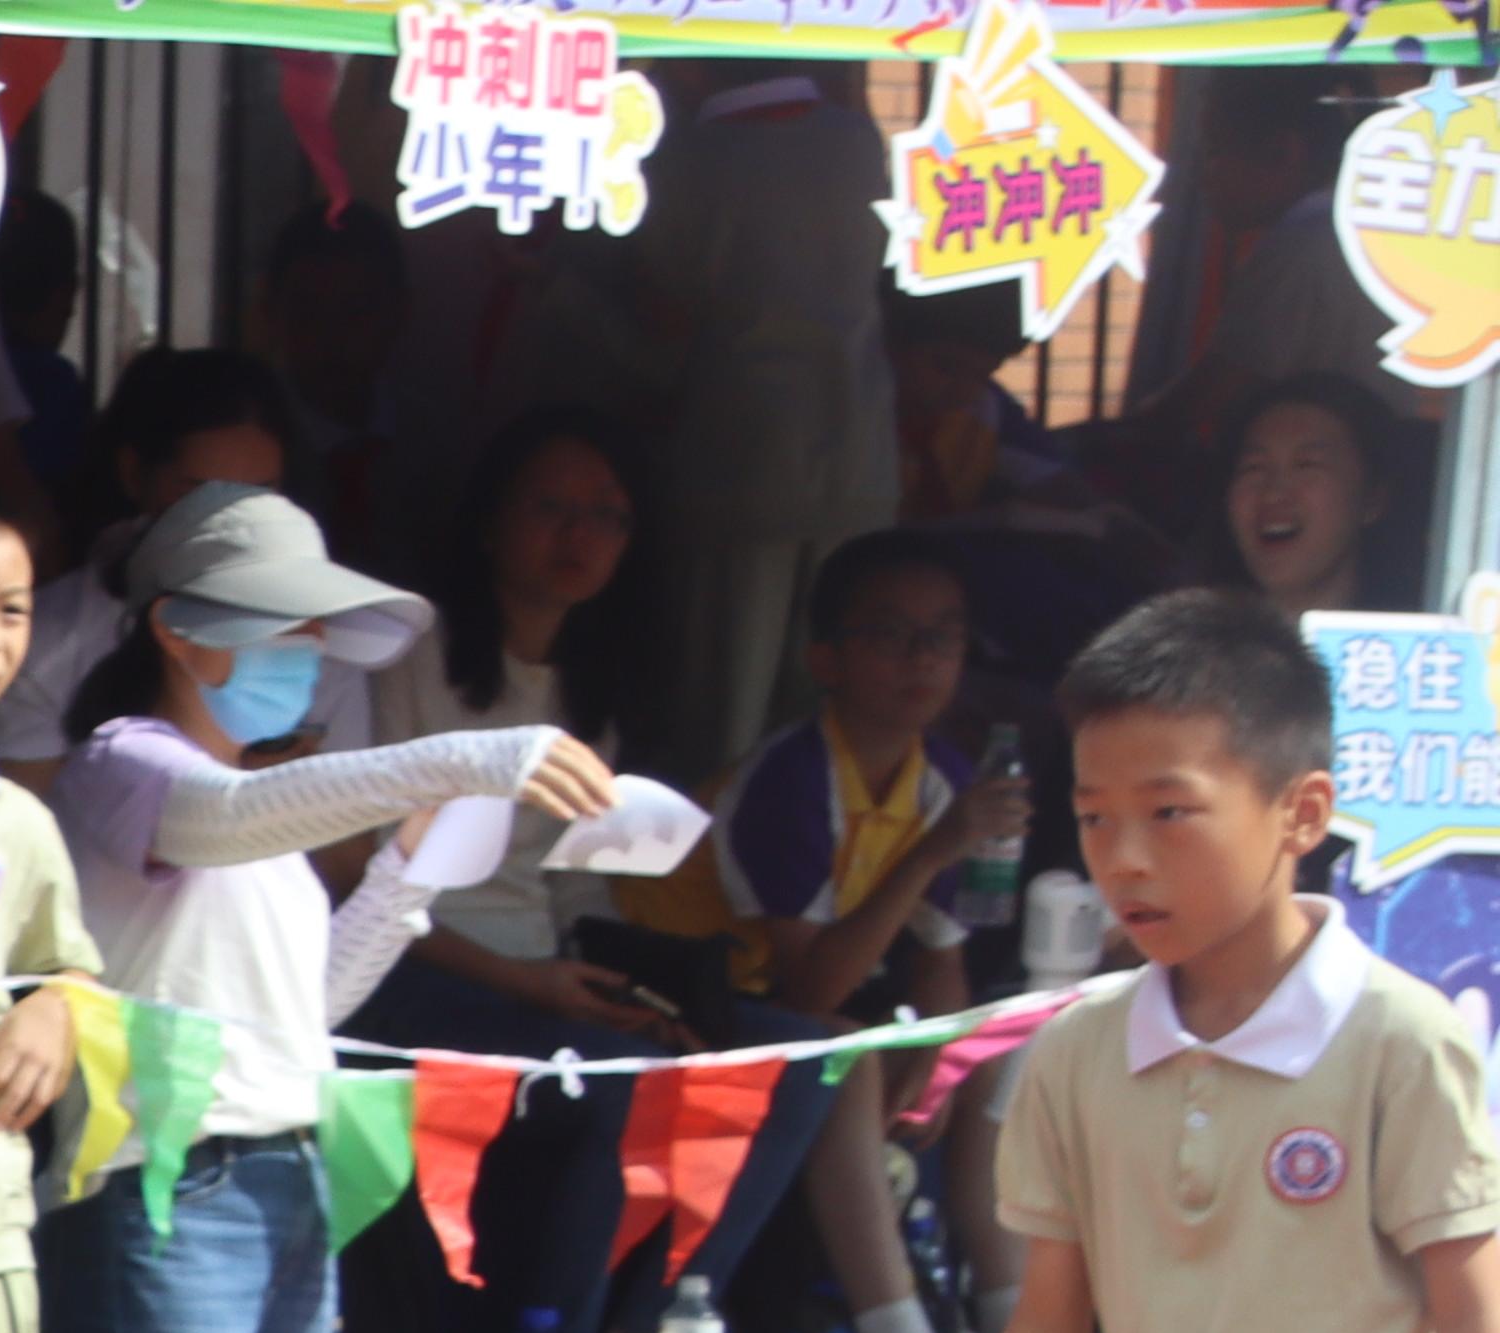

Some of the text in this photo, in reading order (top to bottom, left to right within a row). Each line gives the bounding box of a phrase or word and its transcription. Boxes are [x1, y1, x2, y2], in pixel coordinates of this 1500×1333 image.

[404, 14, 606, 116] 冲刺吧
[933, 147, 1104, 253] 冲冲冲
[1336, 633, 1465, 712] 稳住
[1334, 730, 1500, 806] 我们能
